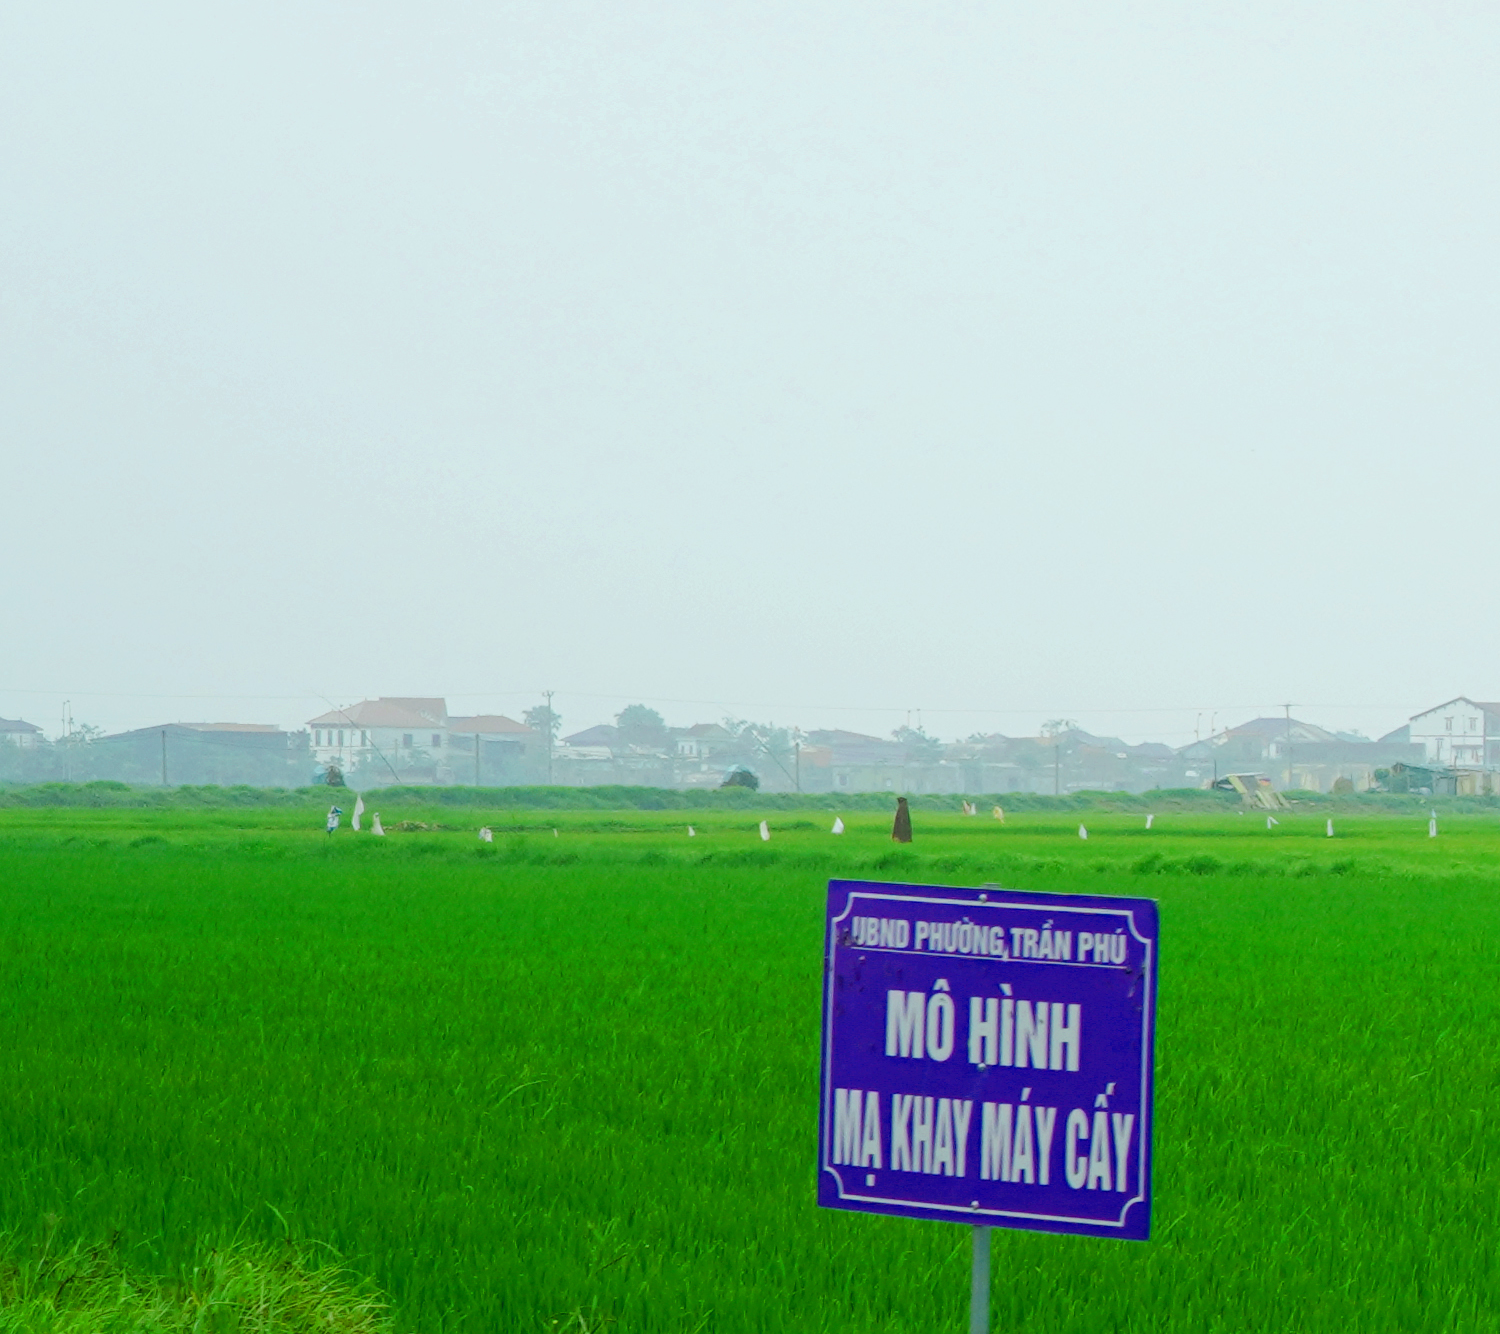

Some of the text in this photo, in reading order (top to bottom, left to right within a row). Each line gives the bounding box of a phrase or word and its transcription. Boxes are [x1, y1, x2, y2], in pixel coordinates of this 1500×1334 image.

[852, 916, 909, 949] UBND
[1077, 927, 1127, 964] PHÚ
[885, 978, 1081, 1072] MÔ HÌNH
[833, 1082, 1134, 1192] MẠ KHAY MÁY CẤY
